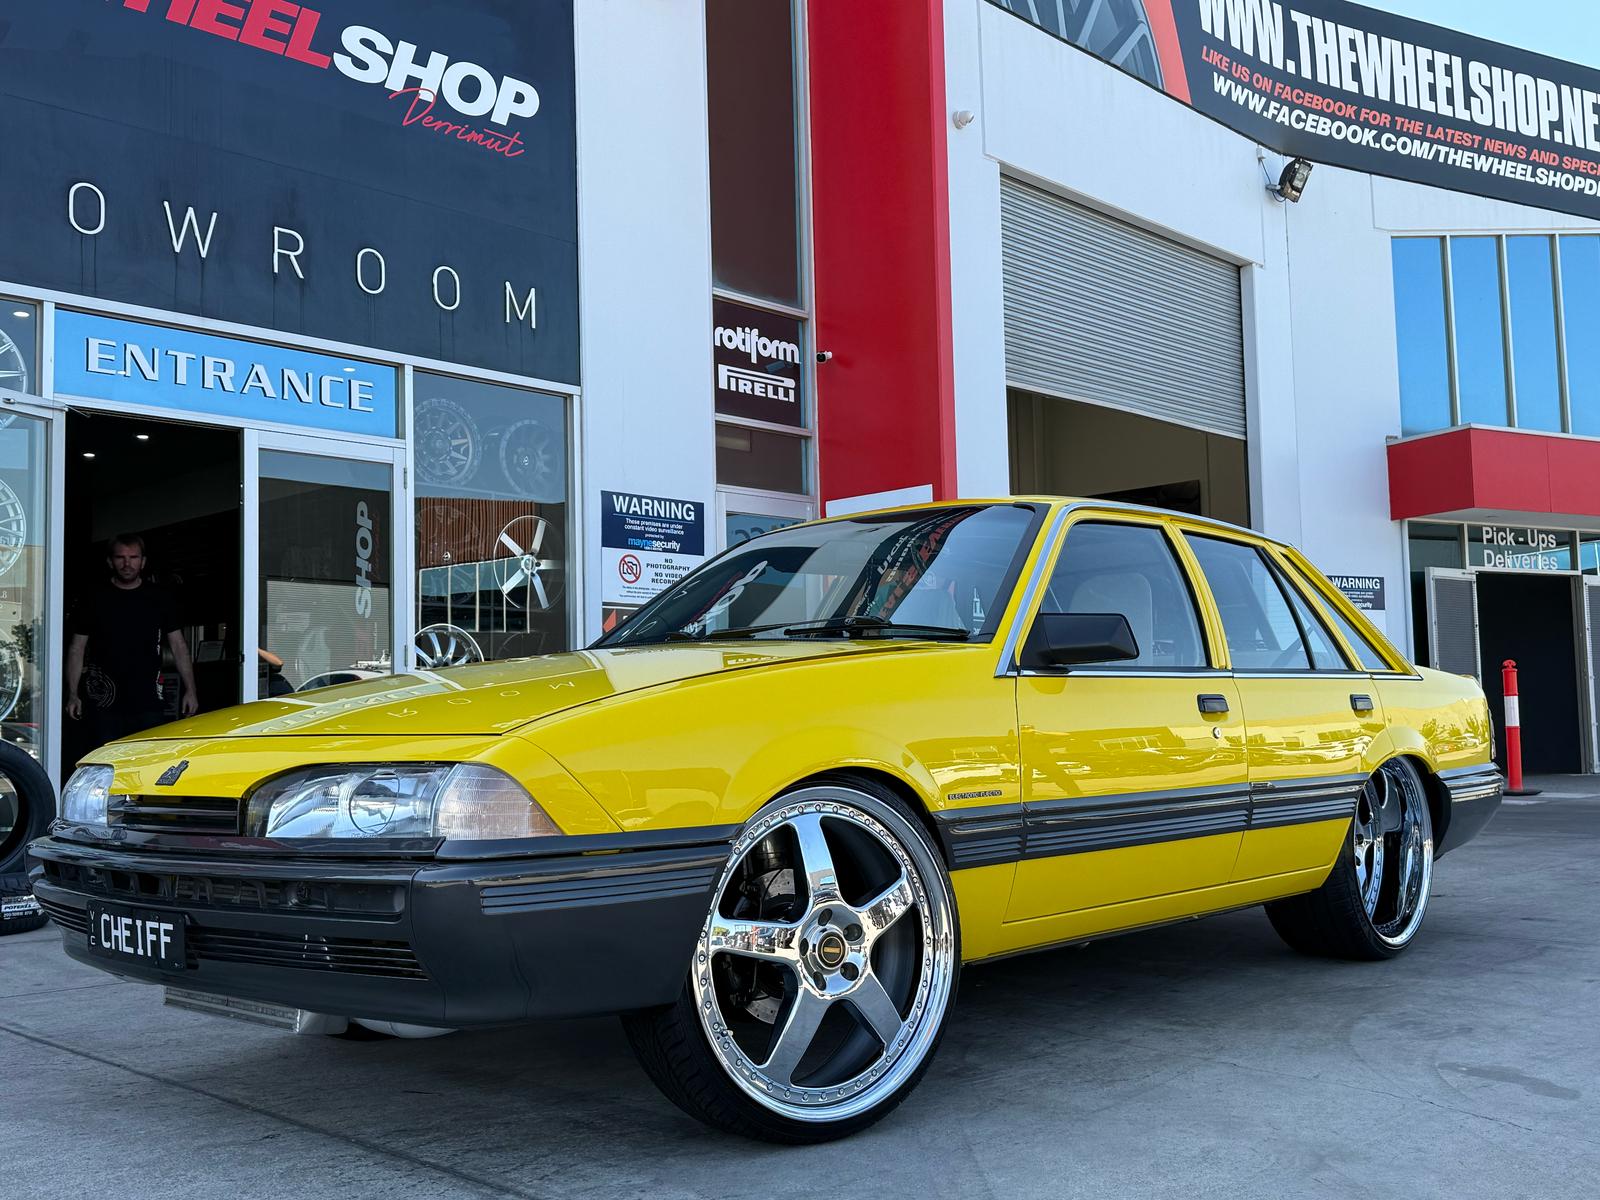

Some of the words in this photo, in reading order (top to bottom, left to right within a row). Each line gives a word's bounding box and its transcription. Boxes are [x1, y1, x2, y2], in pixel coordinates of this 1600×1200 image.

[1199, 0, 1600, 152] WWW.THEWHEELSHOP.NE
[1201, 45, 1230, 73] LIKE
[1231, 61, 1251, 83] US
[1252, 73, 1273, 93] ON
[1274, 82, 1358, 120] FACEBOOK
[1359, 108, 1391, 128] FOR
[1394, 116, 1424, 135] THE
[1425, 123, 1482, 148] LATEST
[1484, 138, 1527, 159] NEWS
[1529, 149, 1559, 166] AND
[1213, 72, 1600, 197] WWW.FACEBOOK.COM/THEWHEELSHOPD
[714, 326, 801, 364] rotiform
[85, 336, 375, 413] ENTRANCE
[718, 364, 796, 403] PIRELLI
[612, 494, 695, 521] WARNING
[626, 517, 640, 525] These
[640, 519, 661, 528] premises
[670, 522, 683, 530] under
[624, 524, 645, 532] constant
[645, 525, 658, 533] video
[1482, 526, 1516, 546] Pick
[1527, 528, 1557, 551] Ups
[355, 500, 373, 619] SHOP
[646, 563, 690, 572] PHOTOGRAPHY
[1483, 549, 1558, 570] Deliveries
[1331, 577, 1380, 589] WARNING
[100, 913, 174, 959] CHEIFF
